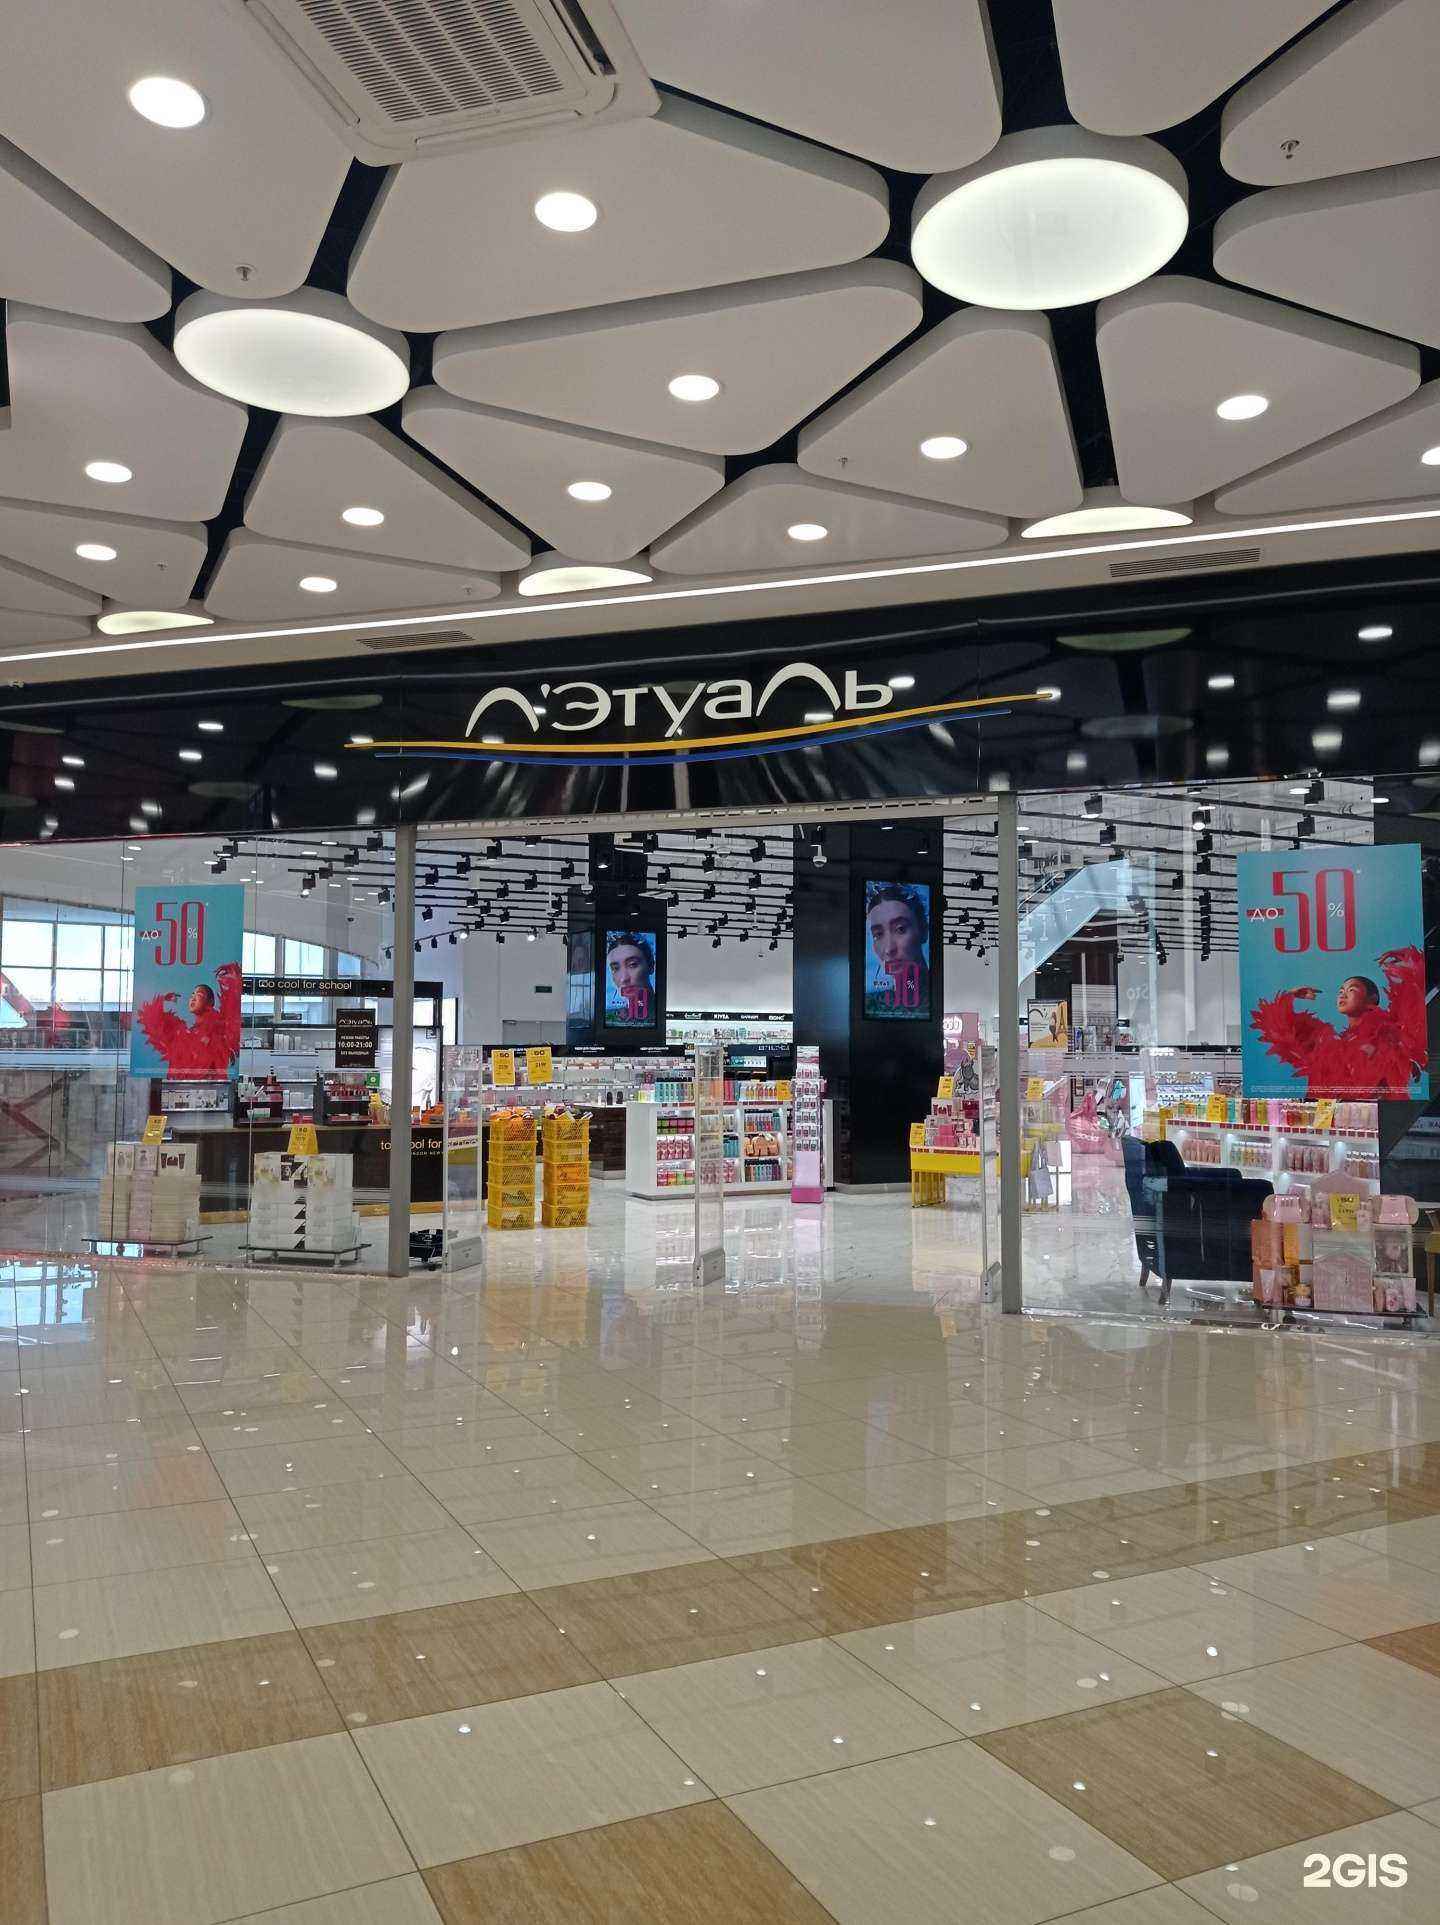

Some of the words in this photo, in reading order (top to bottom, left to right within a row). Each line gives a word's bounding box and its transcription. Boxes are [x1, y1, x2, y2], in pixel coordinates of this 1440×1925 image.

[258, 979, 275, 988] too
[277, 980, 300, 989] cool
[302, 980, 317, 989] for
[319, 981, 352, 990] school
